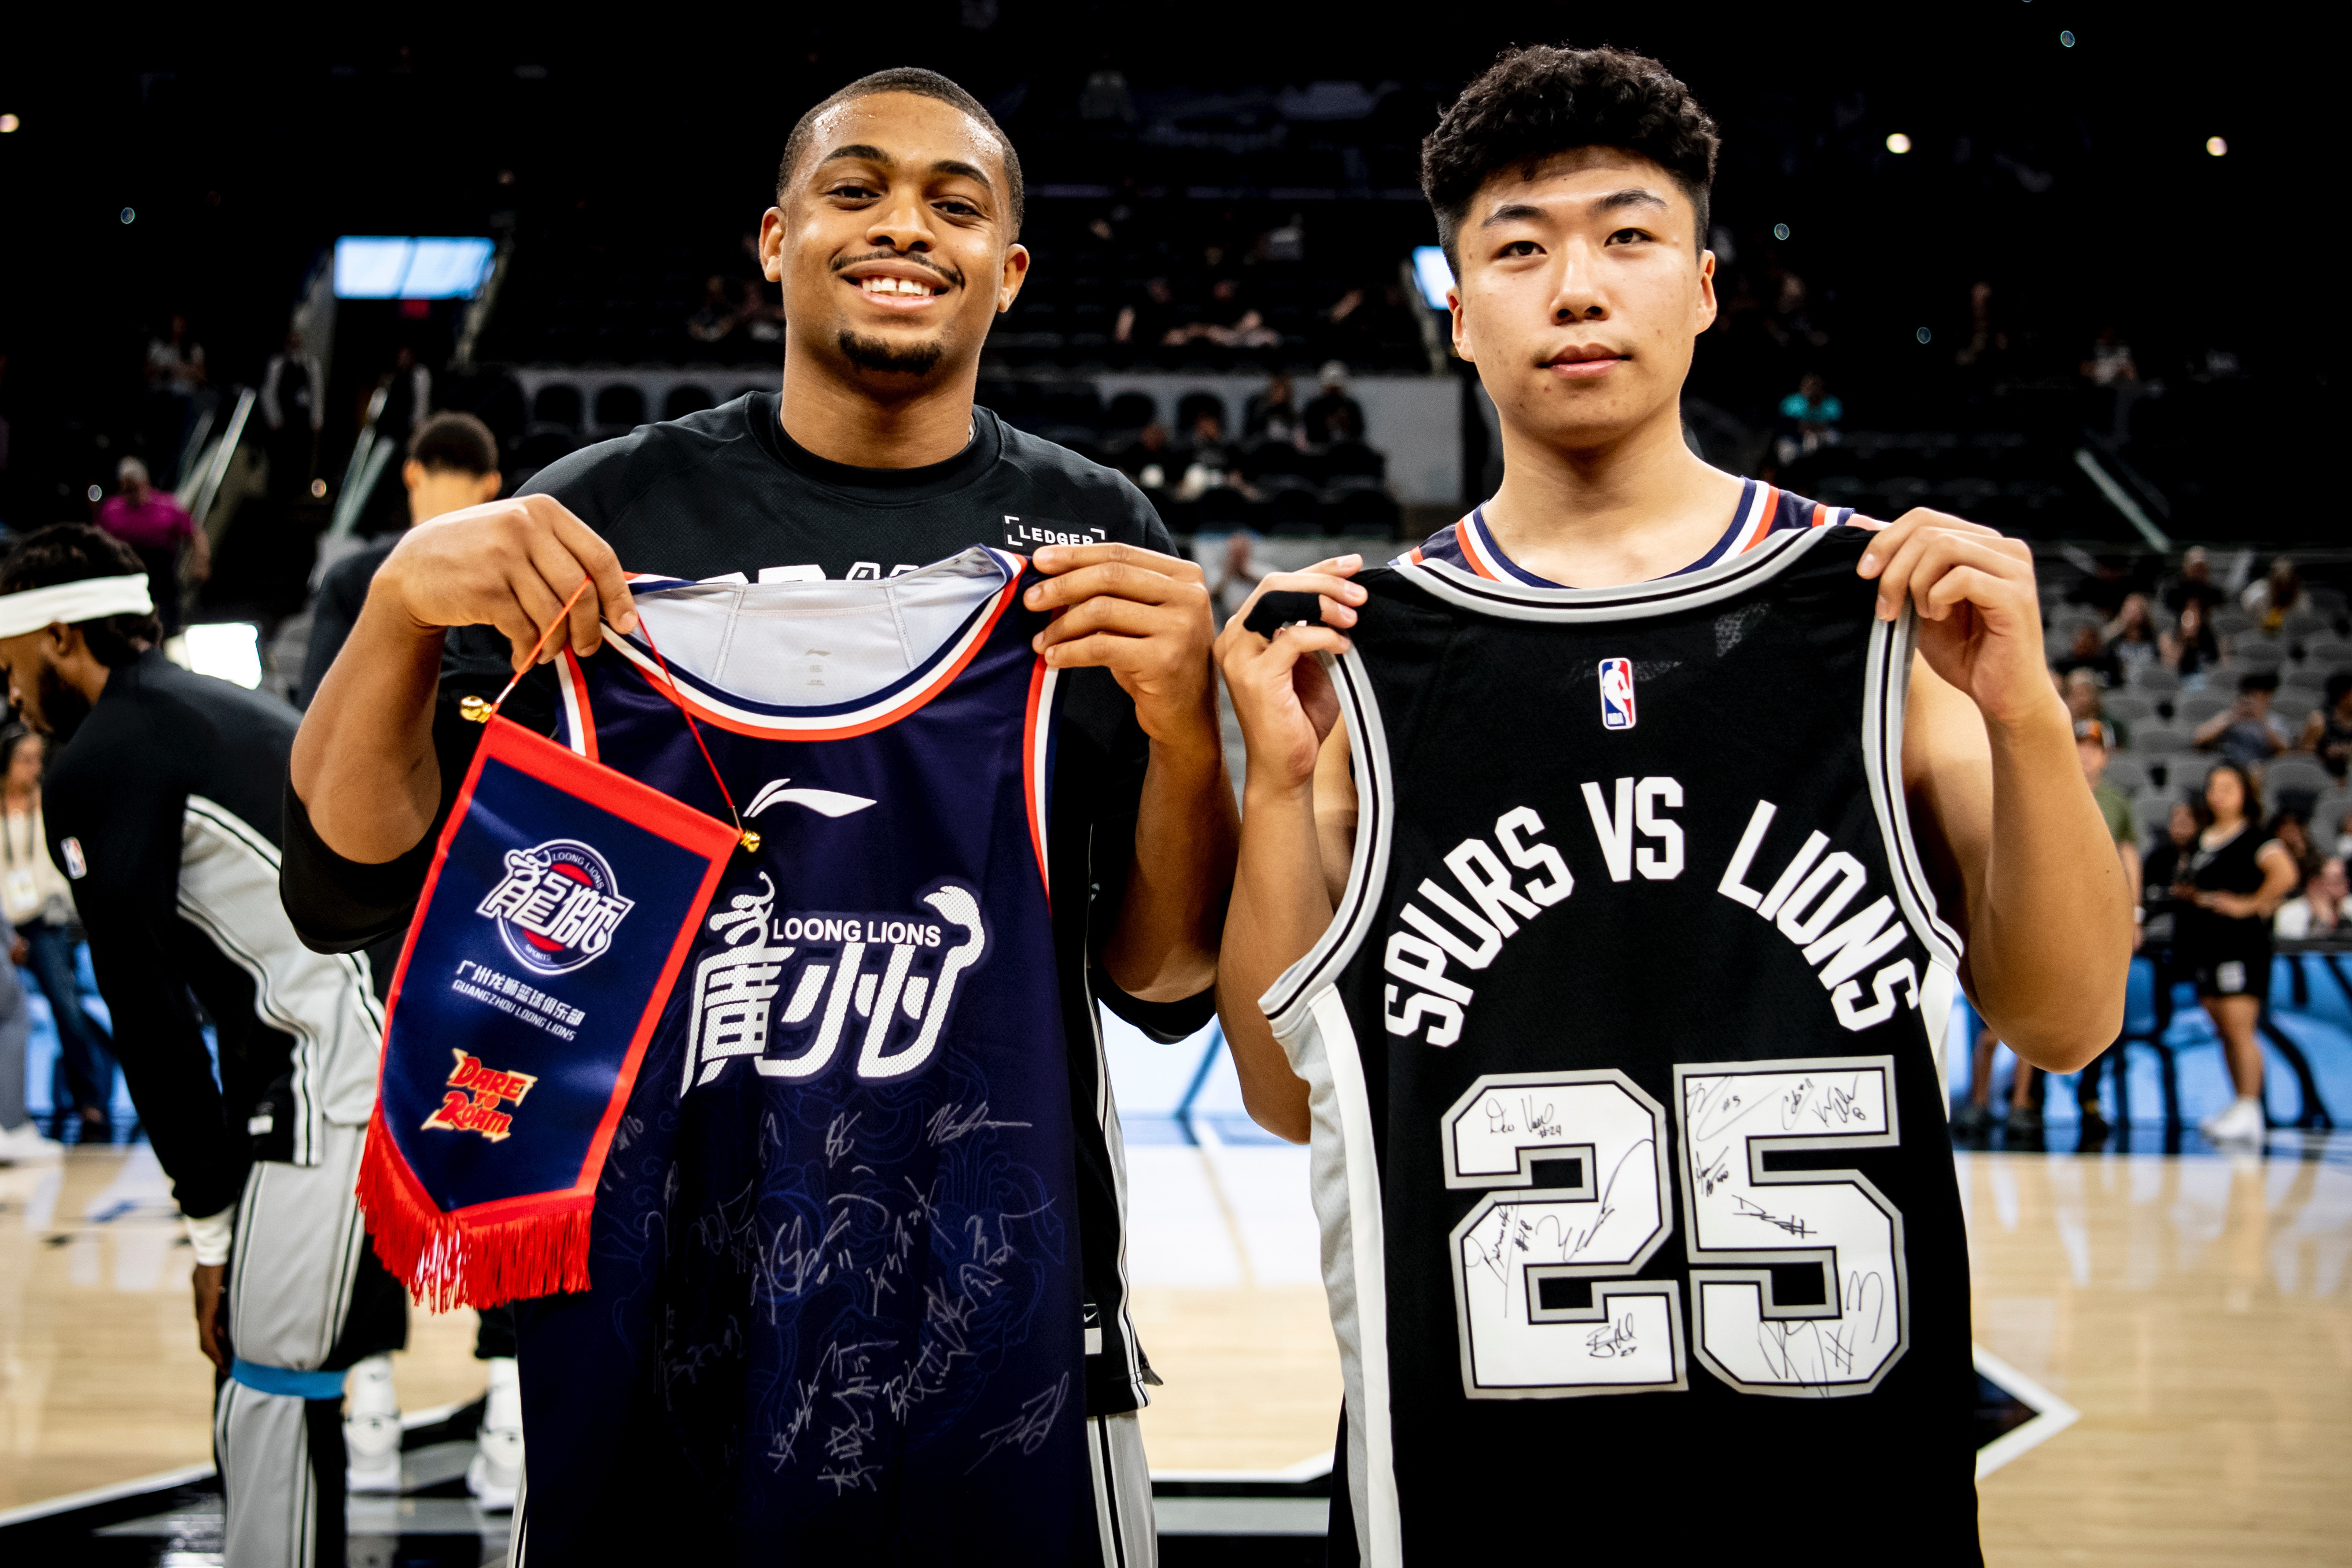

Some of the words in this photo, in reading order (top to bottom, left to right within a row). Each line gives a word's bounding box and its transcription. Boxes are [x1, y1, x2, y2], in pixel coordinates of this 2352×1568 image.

[1019, 525, 1094, 545] LEDGER
[552, 851, 585, 865] LOONG
[584, 861, 605, 890] LIONS
[773, 917, 861, 942] LOONG
[867, 921, 941, 947] LIONS
[1384, 806, 1575, 1047] SPURS
[1580, 776, 1684, 882] VS
[1716, 799, 1920, 1032] LIONS
[525, 943, 552, 961] SPORTS
[451, 979, 517, 1013] GUANGZHOU
[514, 1006, 547, 1028] LOONG
[545, 1020, 577, 1042] LIONS
[456, 960, 586, 1027] 广州龙狮篮球俱乐部
[446, 1056, 528, 1102] DARE
[474, 1090, 500, 1110] TO
[1441, 1055, 1910, 1400] 25
